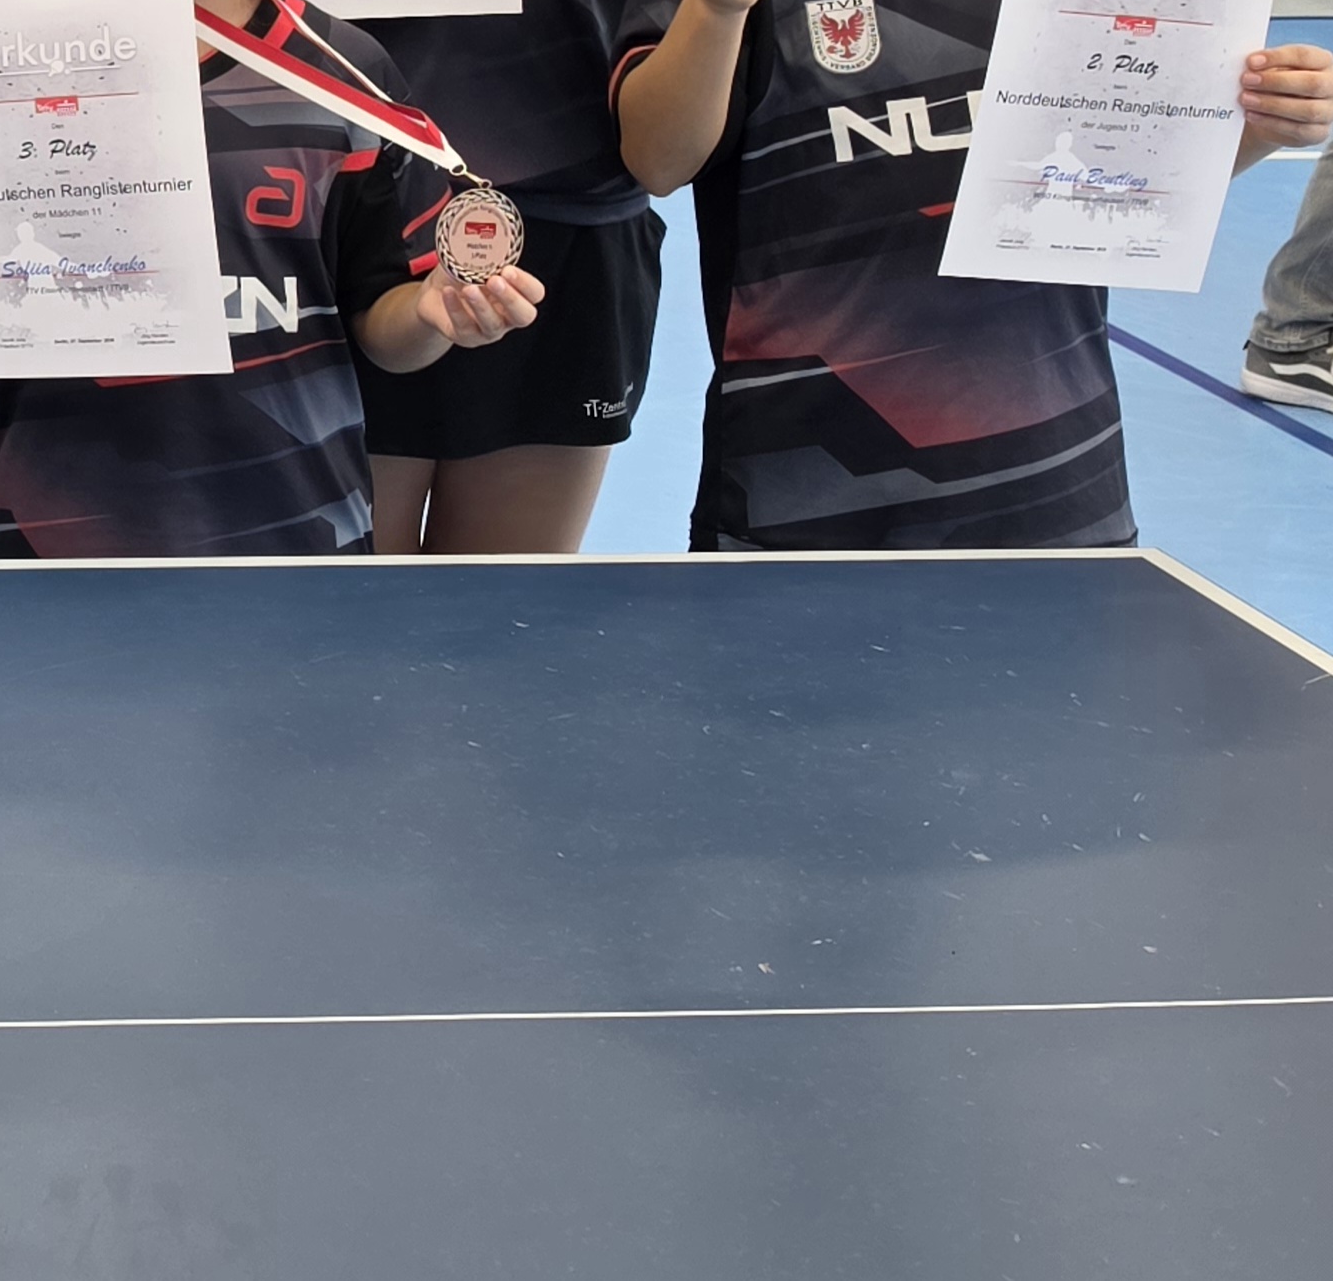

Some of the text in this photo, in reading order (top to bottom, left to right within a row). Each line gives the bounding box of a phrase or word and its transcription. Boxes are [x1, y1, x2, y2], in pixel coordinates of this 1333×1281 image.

[1113, 54, 1160, 79] Platz
[996, 90, 1234, 121] Norddeutschen Ranglistenturnier
[48, 138, 98, 161] Platz
[1040, 165, 1083, 183] Paul
[60, 177, 193, 199] Ranglistenturnier
